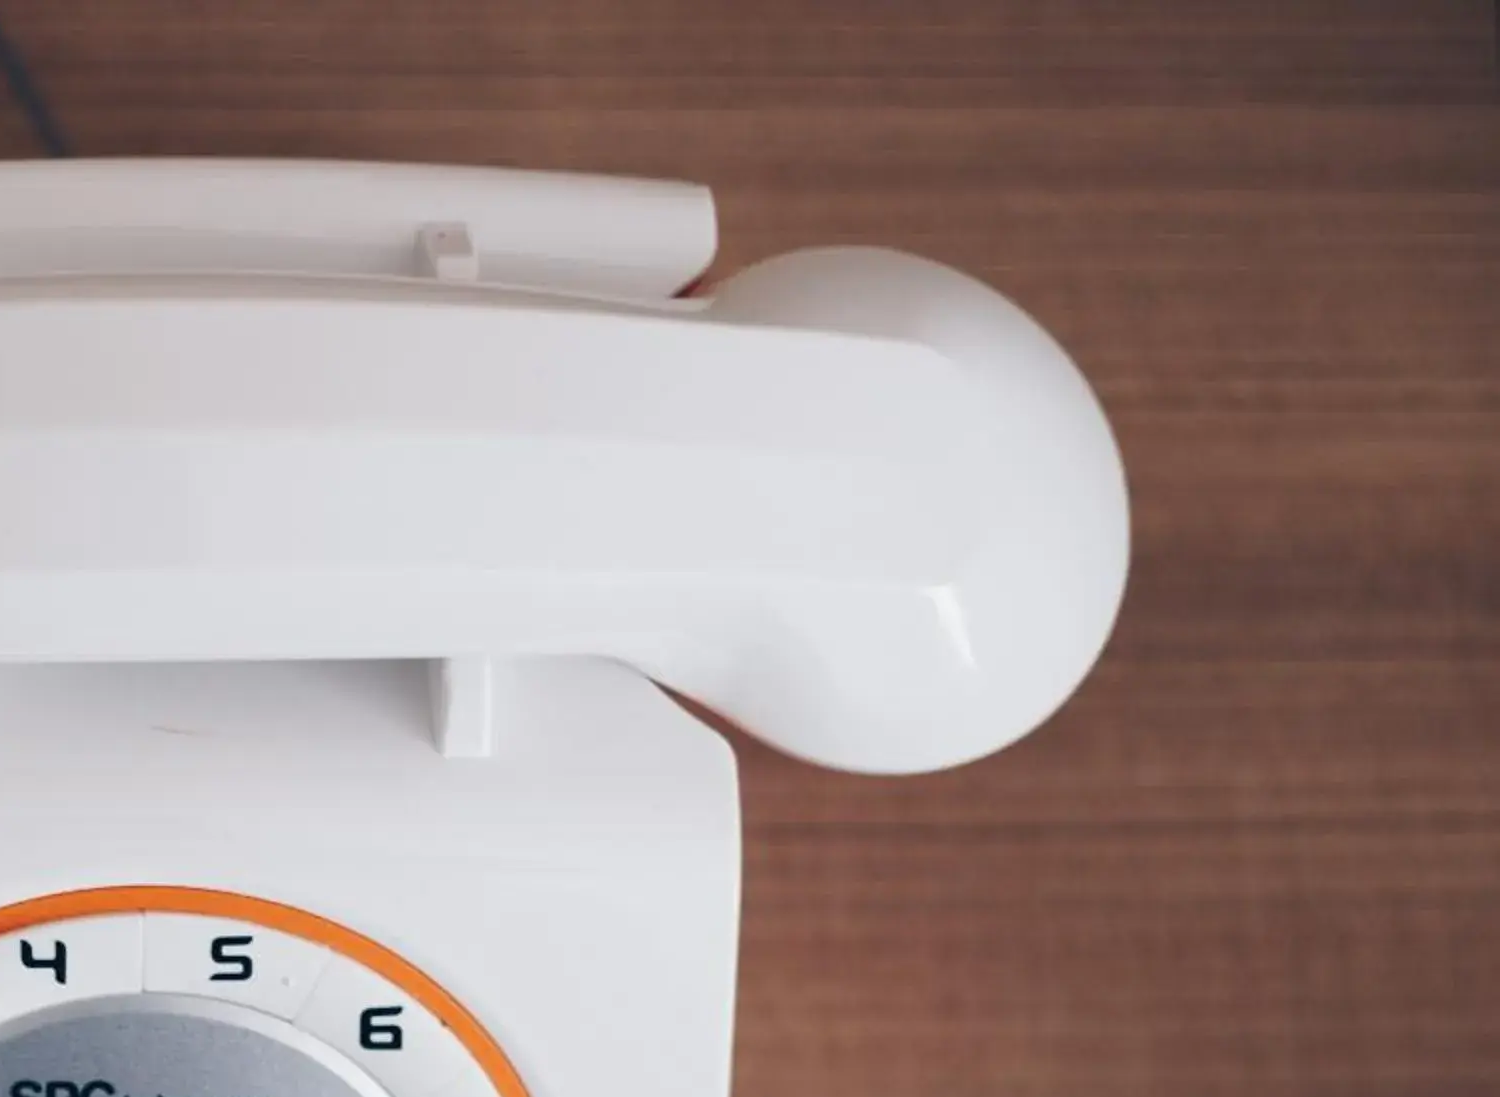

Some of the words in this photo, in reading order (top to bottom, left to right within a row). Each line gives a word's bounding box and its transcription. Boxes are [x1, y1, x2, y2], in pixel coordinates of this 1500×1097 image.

[20, 938, 68, 985] 4
[209, 935, 254, 981] 5
[359, 1005, 404, 1051] 6
